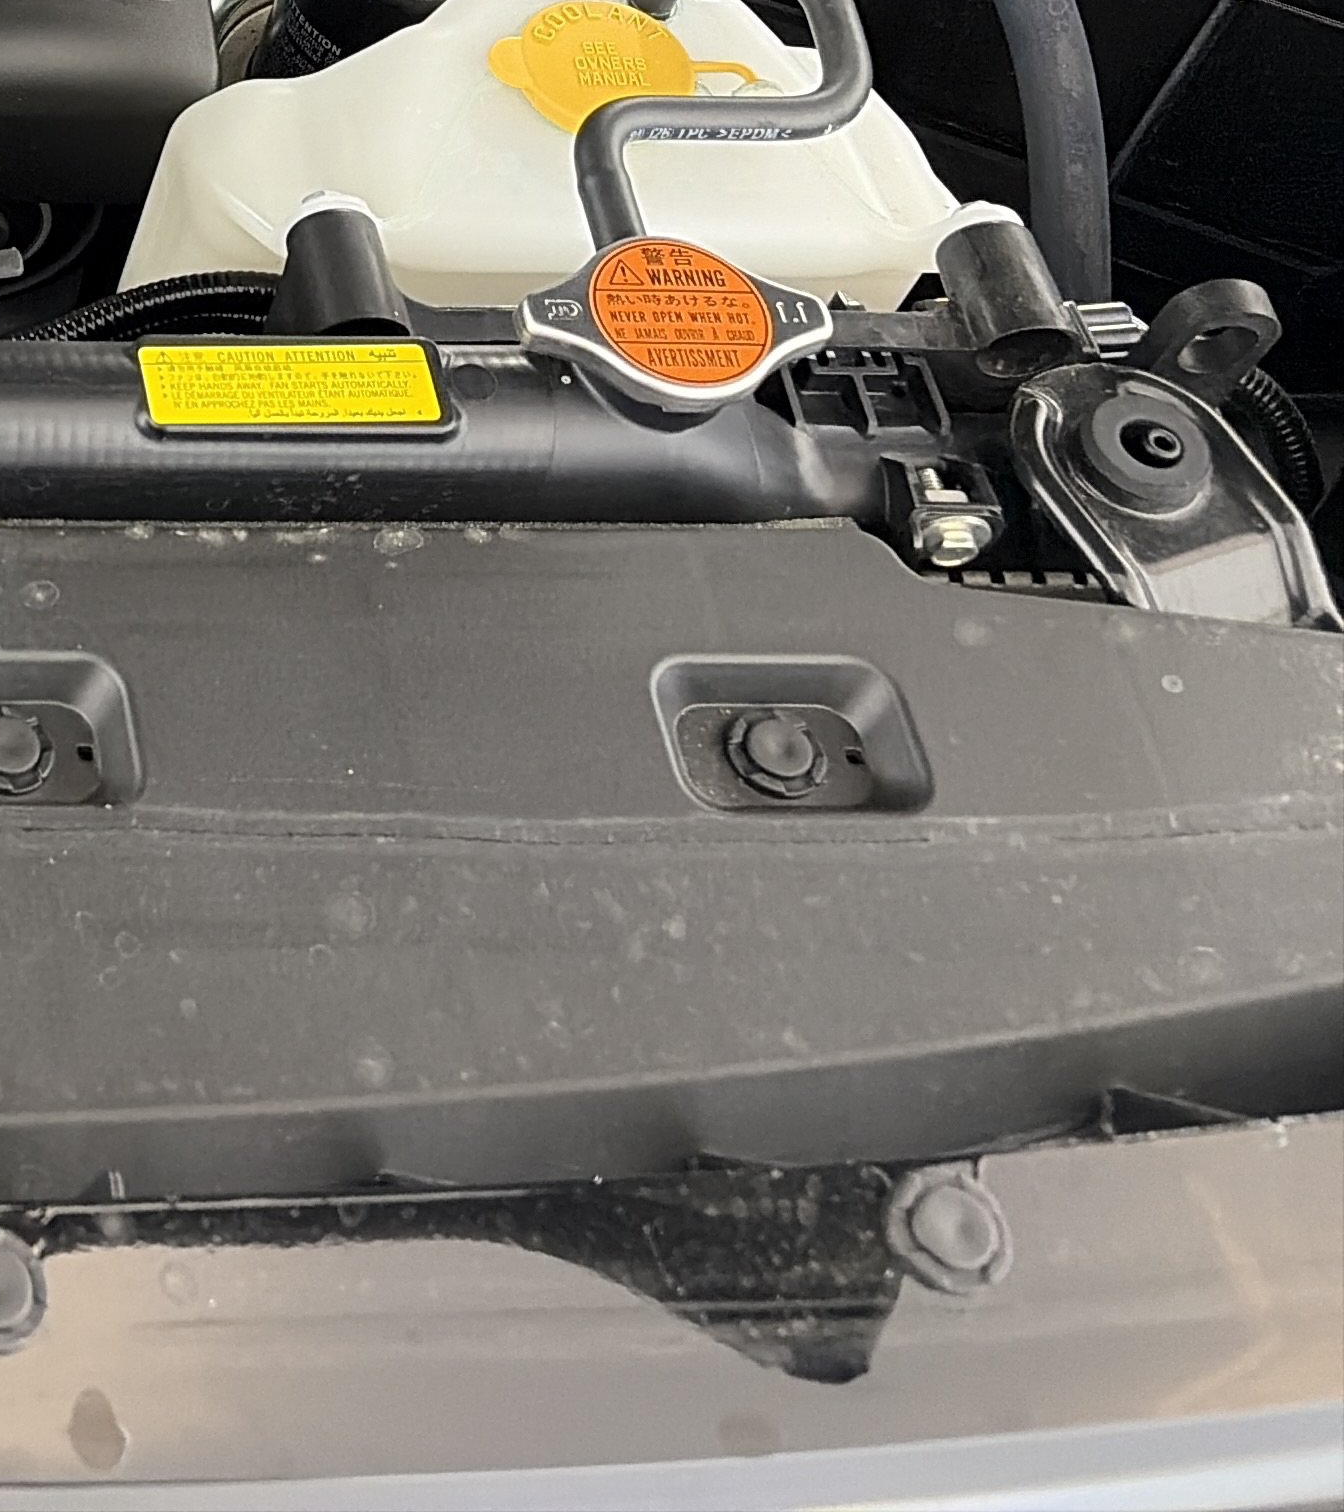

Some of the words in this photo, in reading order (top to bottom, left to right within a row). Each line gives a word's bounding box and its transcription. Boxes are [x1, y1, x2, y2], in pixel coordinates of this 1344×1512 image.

[533, 2, 668, 44] COOLANT
[581, 41, 618, 56] SEE
[574, 56, 647, 71] OWNERS
[578, 70, 652, 87] MANUAL
[639, 247, 694, 266] 警告
[645, 268, 727, 288] WARNING
[608, 311, 647, 324] NEVER
[653, 311, 684, 324] OPEN
[687, 311, 722, 324] WHEN
[614, 327, 627, 339] NE
[634, 327, 668, 340] JAMAIS
[216, 351, 275, 363] CAUTION
[284, 350, 356, 362] ATTENTION
[170, 382, 195, 390] KEEP
[199, 382, 234, 390] HANDS
[270, 381, 289, 390] FAN
[292, 380, 327, 389] STARTS
[256, 390, 316, 399] VENTILATEUR
[258, 399, 274, 408] PAS
[277, 399, 295, 408] LES
